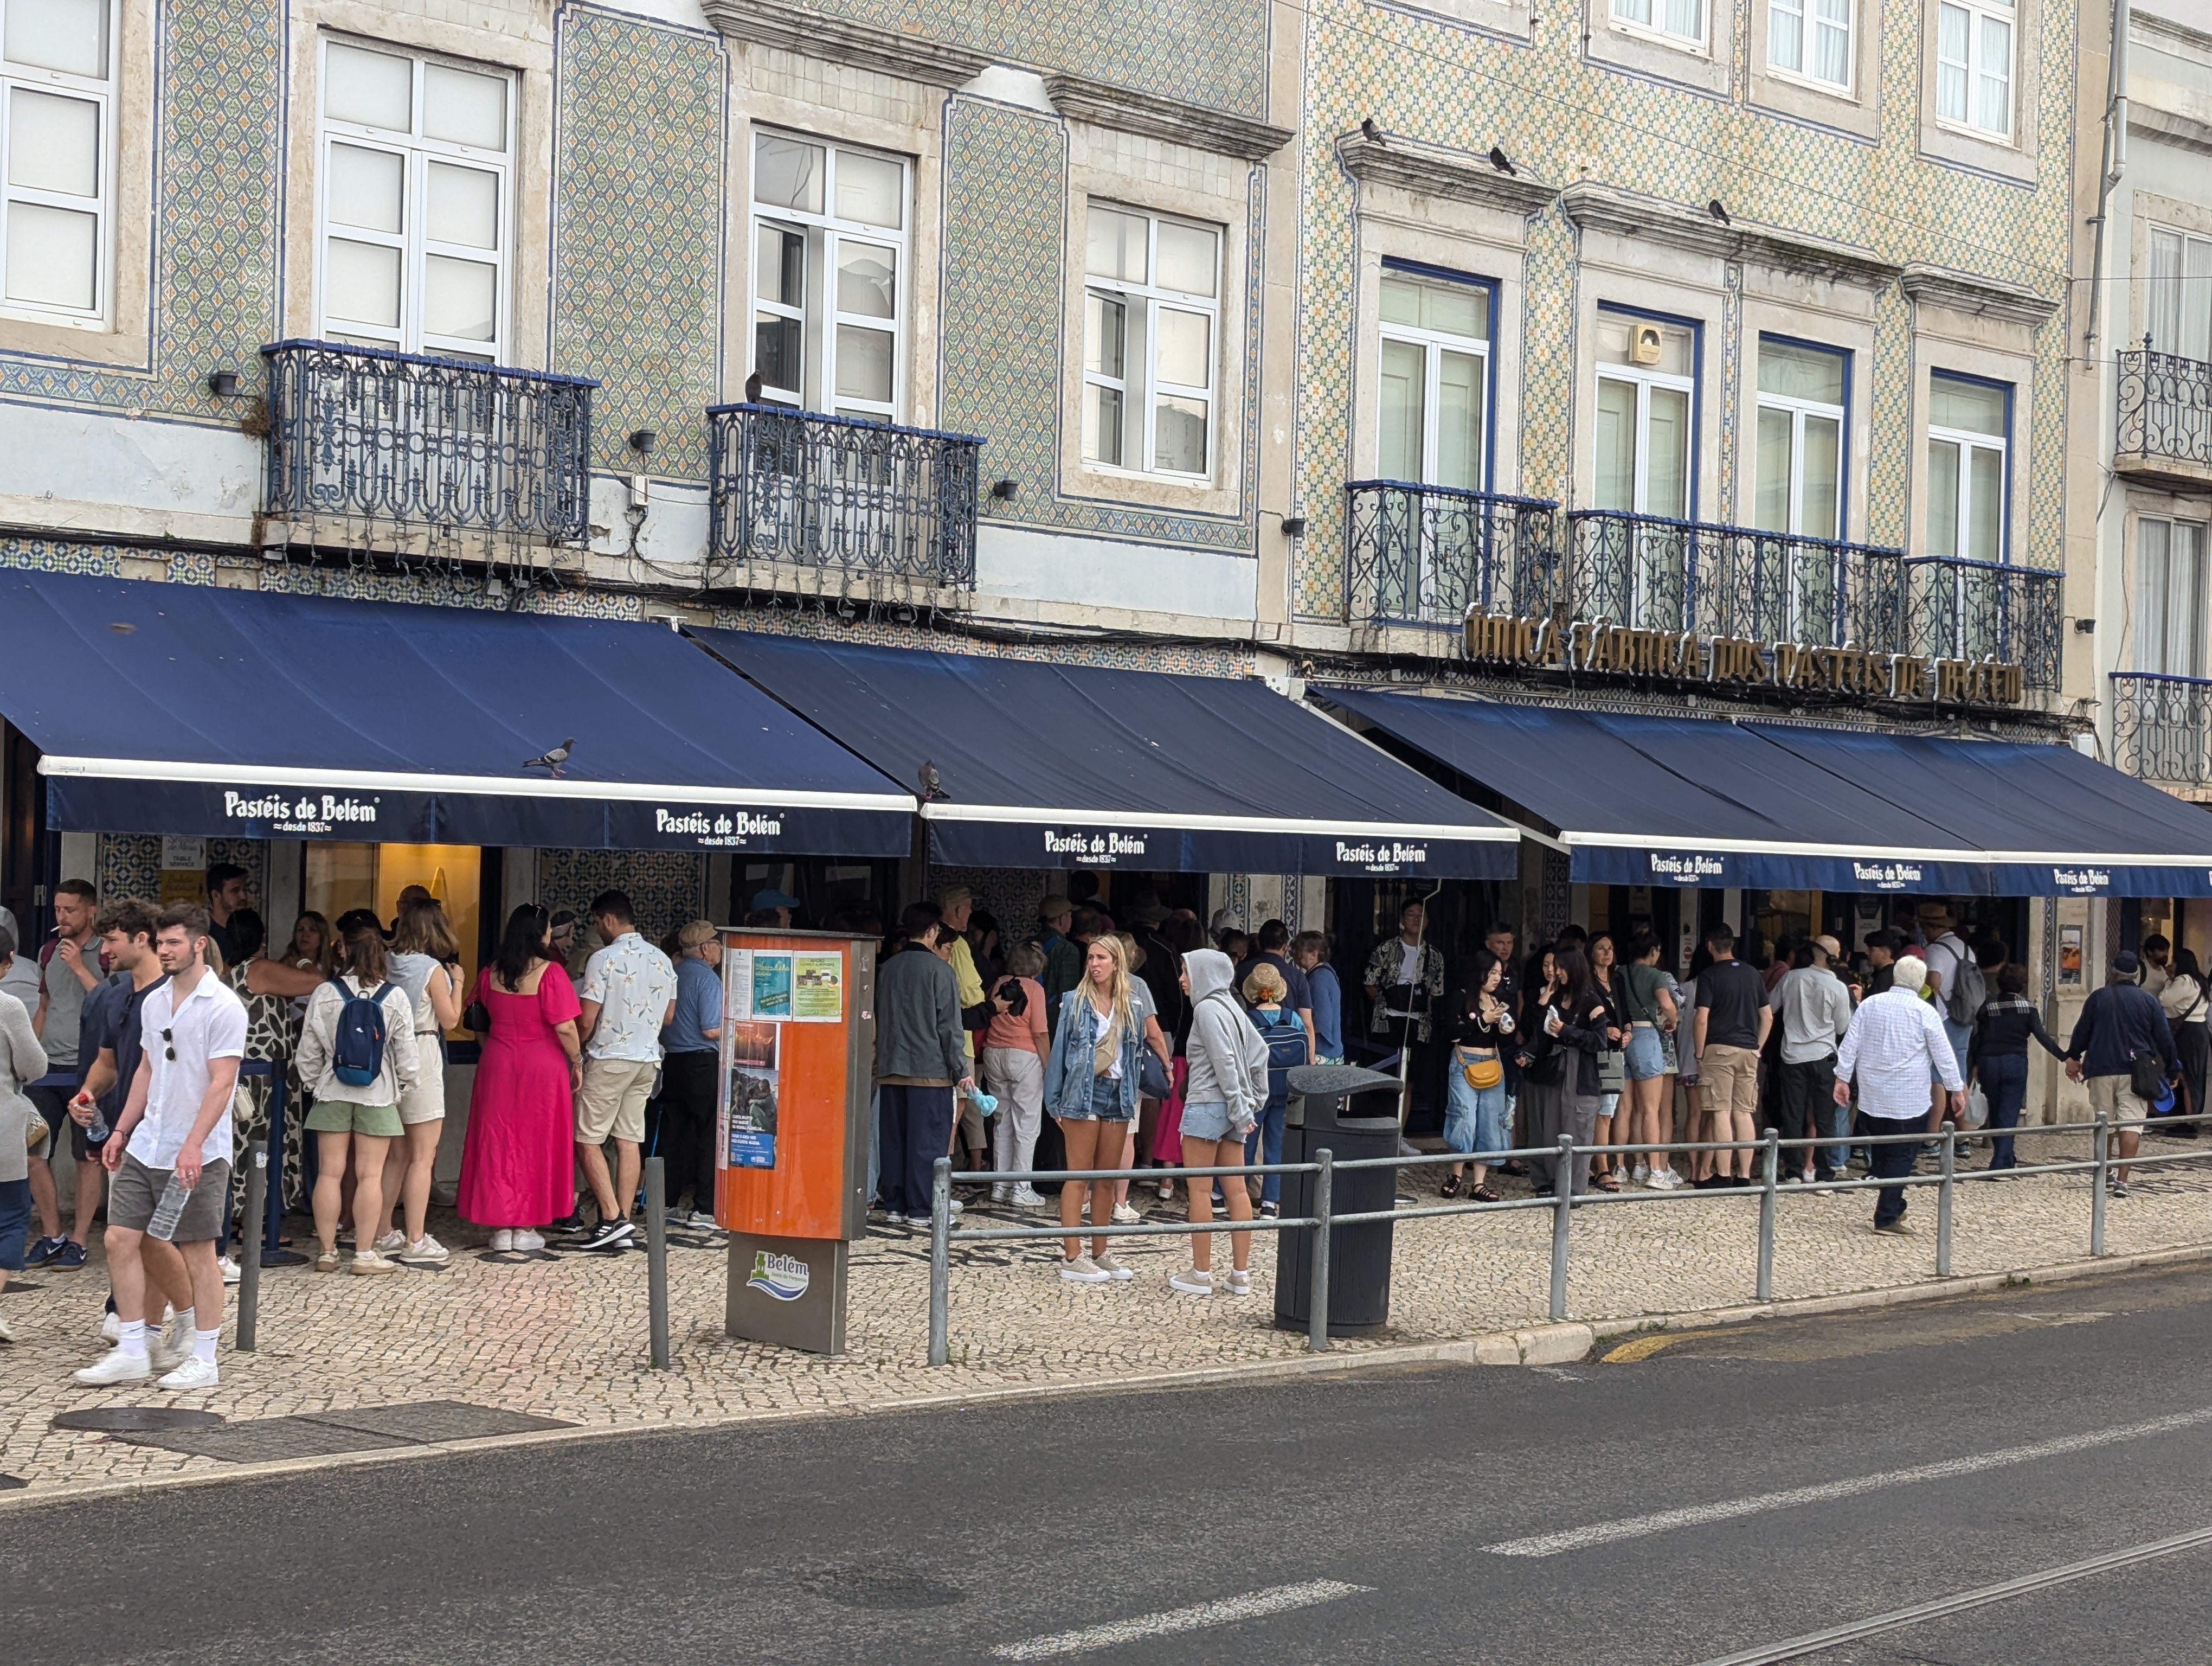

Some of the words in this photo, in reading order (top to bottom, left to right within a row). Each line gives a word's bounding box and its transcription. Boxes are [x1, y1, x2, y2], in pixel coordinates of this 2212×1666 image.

[1707, 635, 1766, 683] DOS
[1890, 653, 1929, 699] DE
[224, 791, 291, 819] Pastéis
[295, 797, 317, 820] de
[321, 794, 376, 822] Belém
[282, 821, 306, 831] desde
[307, 821, 325, 832] 1837
[655, 808, 711, 834] Pastéis
[714, 813, 732, 835] de
[736, 811, 781, 836] Belém
[704, 836, 723, 845] desde
[724, 836, 740, 845] 1837
[1044, 830, 1088, 853] Pastéis
[1090, 834, 1106, 853] de
[1108, 832, 1145, 854] Belém
[1336, 842, 1375, 862] Pastéis
[1377, 844, 1391, 862] de
[1393, 843, 1426, 863] Belém
[1651, 853, 1682, 873] Pastéis
[1683, 857, 1693, 873] de
[1694, 855, 1722, 874] Belém
[1885, 865, 1895, 880] de
[2079, 871, 2088, 885] de
[767, 1254, 808, 1276] Belém
